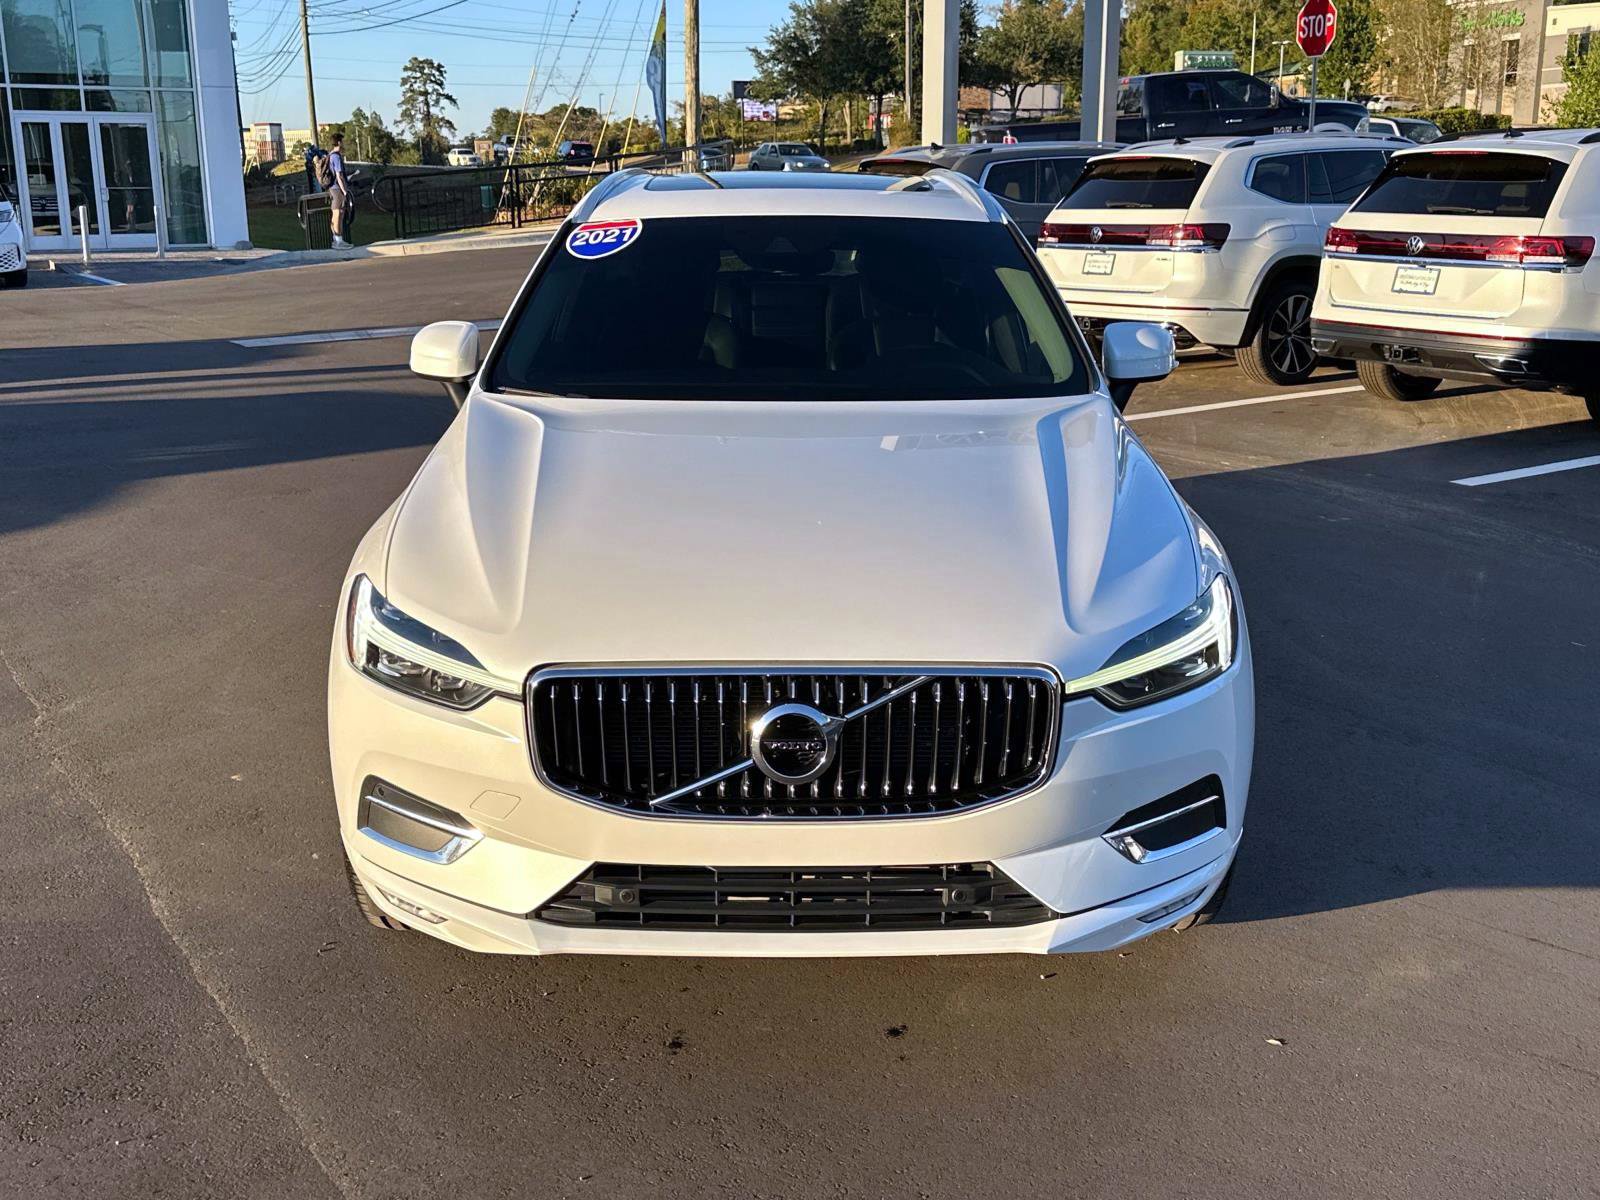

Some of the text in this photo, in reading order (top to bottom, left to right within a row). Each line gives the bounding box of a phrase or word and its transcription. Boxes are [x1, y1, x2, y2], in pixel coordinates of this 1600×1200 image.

[1300, 13, 1334, 38] STOP
[572, 228, 633, 246] 2021
[763, 741, 822, 750] VOLVO
